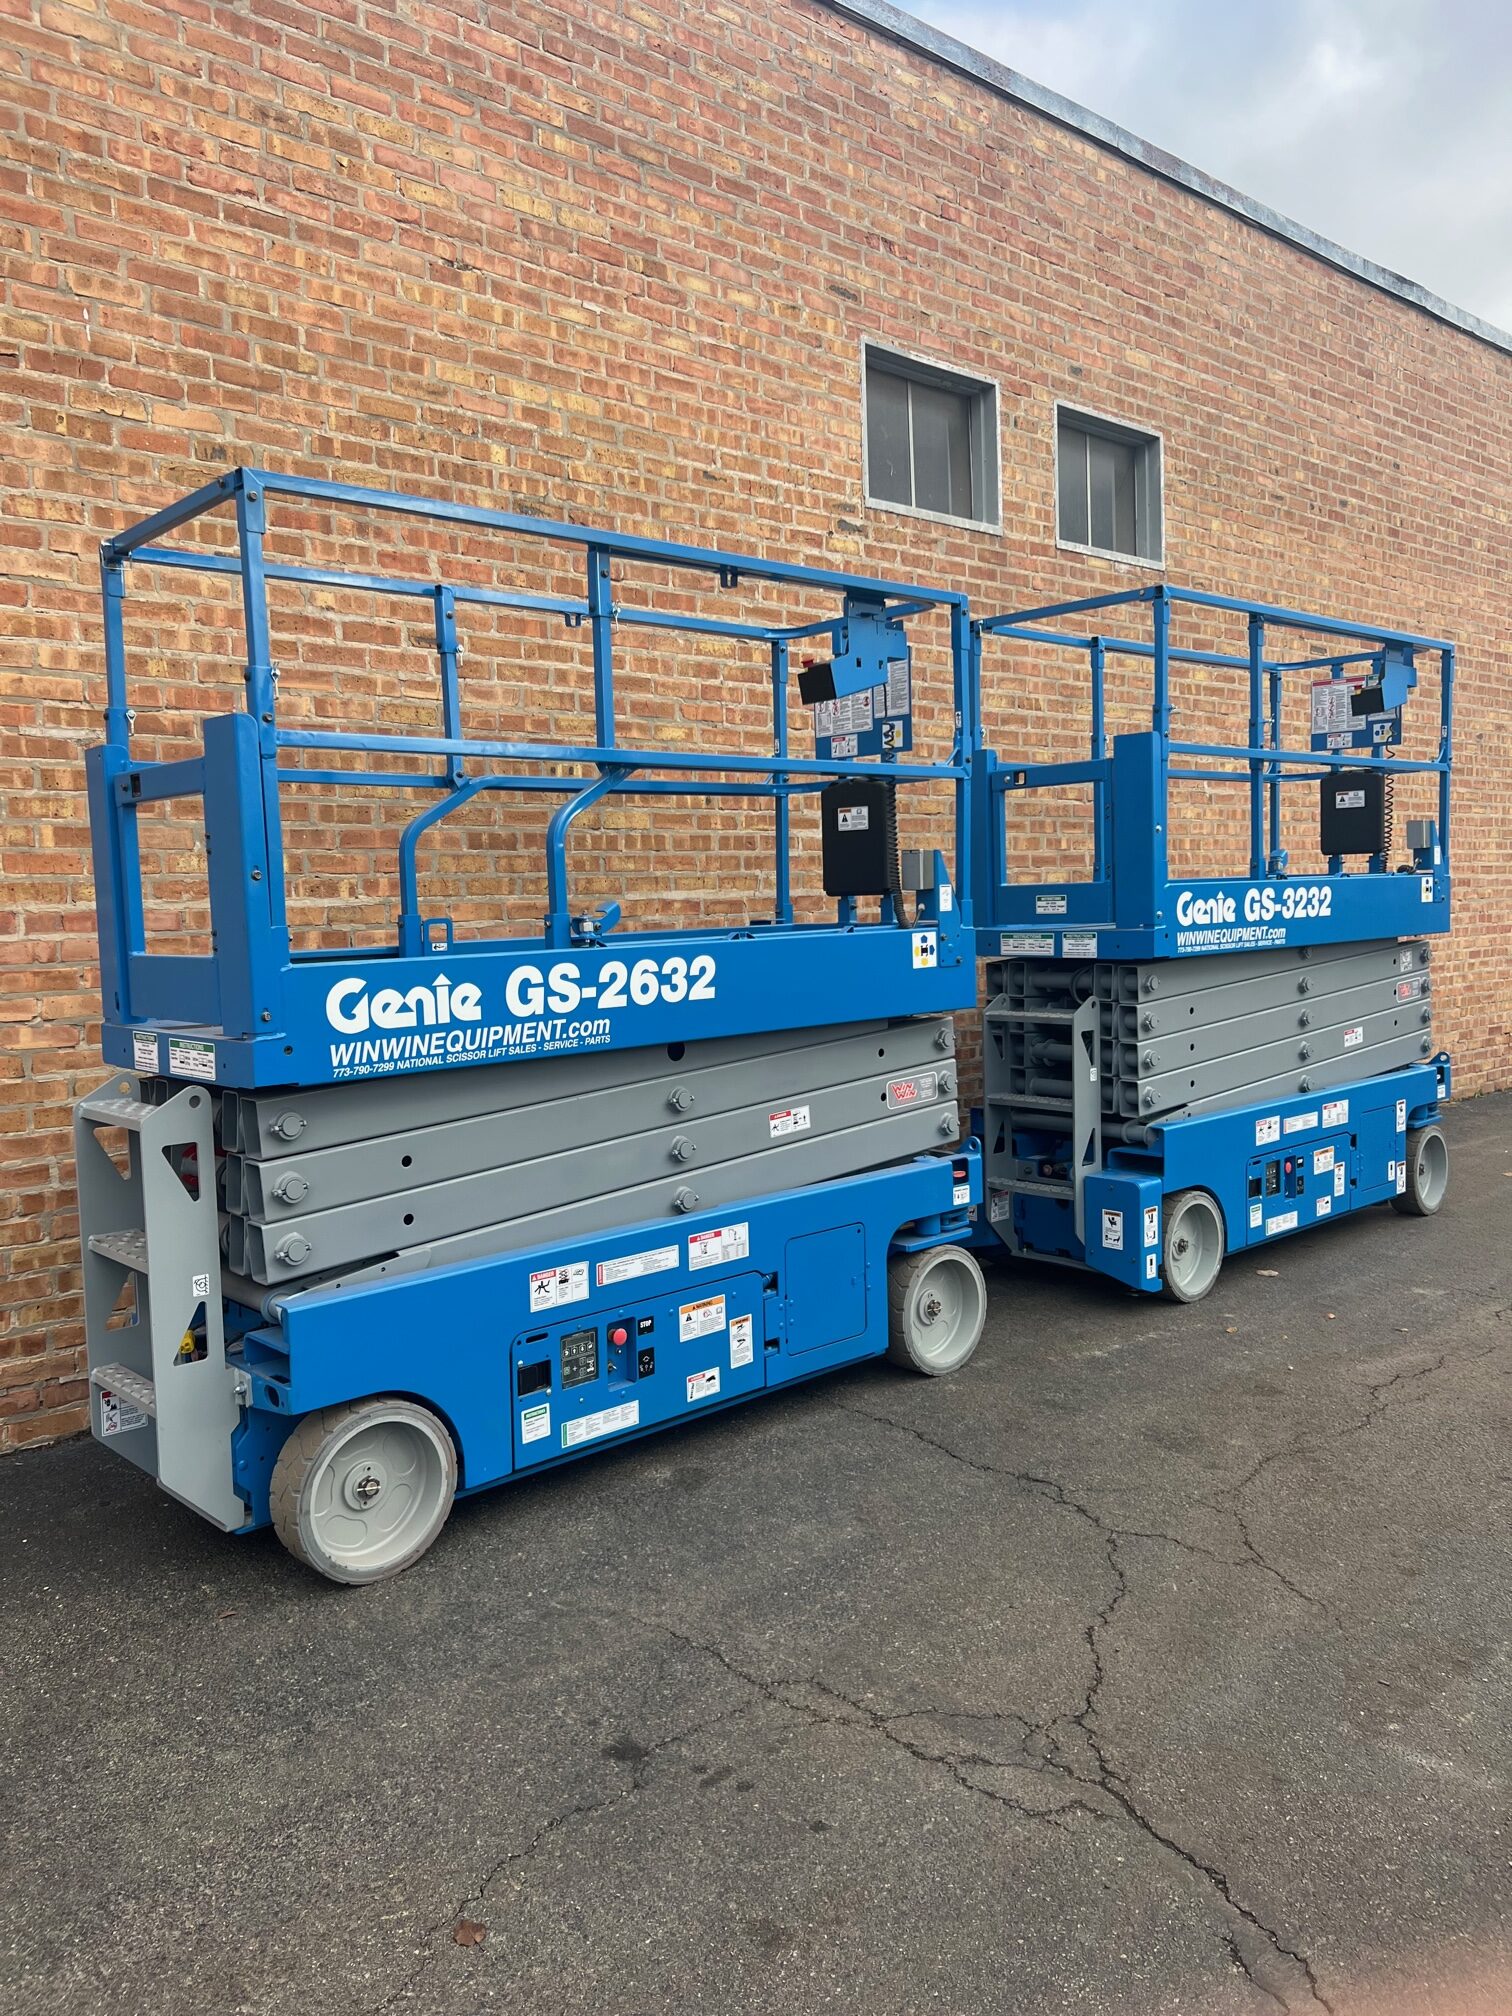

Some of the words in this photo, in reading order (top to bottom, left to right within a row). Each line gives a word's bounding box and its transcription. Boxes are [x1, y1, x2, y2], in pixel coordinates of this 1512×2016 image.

[1176, 890, 1236, 927] Genie
[1244, 885, 1332, 921] GS-3232
[1177, 926, 1286, 946] WINWINEQUIPMENT.com
[326, 973, 482, 1034] Genie
[505, 955, 717, 1018] GS-2632
[330, 1018, 611, 1067] WINWINEQUIPMENT.com
[333, 1061, 395, 1078] 773-790-7299
[396, 1055, 444, 1070] NATIONAL
[446, 1049, 487, 1063] SCISSOR
[488, 1047, 508, 1058] LIFT
[508, 1043, 537, 1055] SALES
[543, 1038, 579, 1051] SERVICE
[585, 1035, 611, 1046] PARTS
[640, 1319, 652, 1328] STOP
